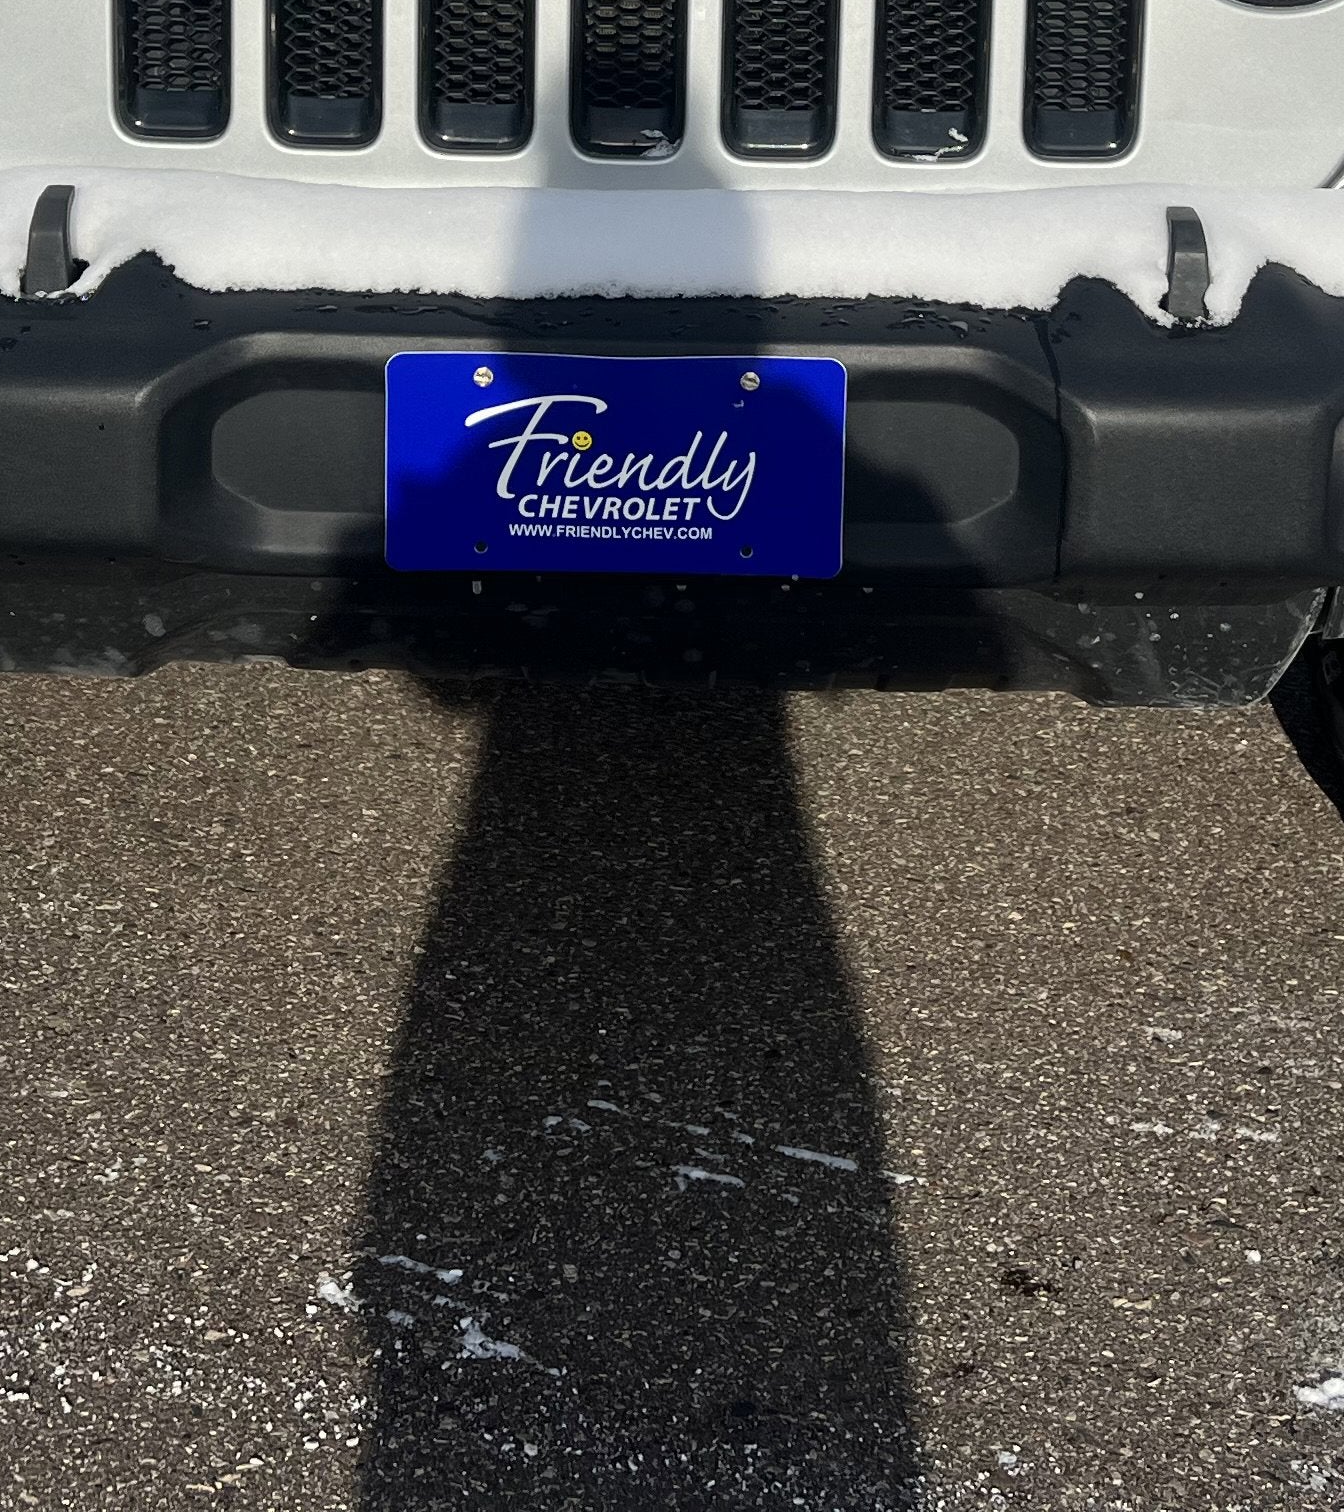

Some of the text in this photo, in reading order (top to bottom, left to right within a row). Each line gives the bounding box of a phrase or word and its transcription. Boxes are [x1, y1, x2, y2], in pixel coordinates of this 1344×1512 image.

[464, 394, 756, 521] Friendly
[518, 494, 701, 521] CHEVROLET
[508, 523, 713, 540] WWW.FRIENDLYCHEV.COM
